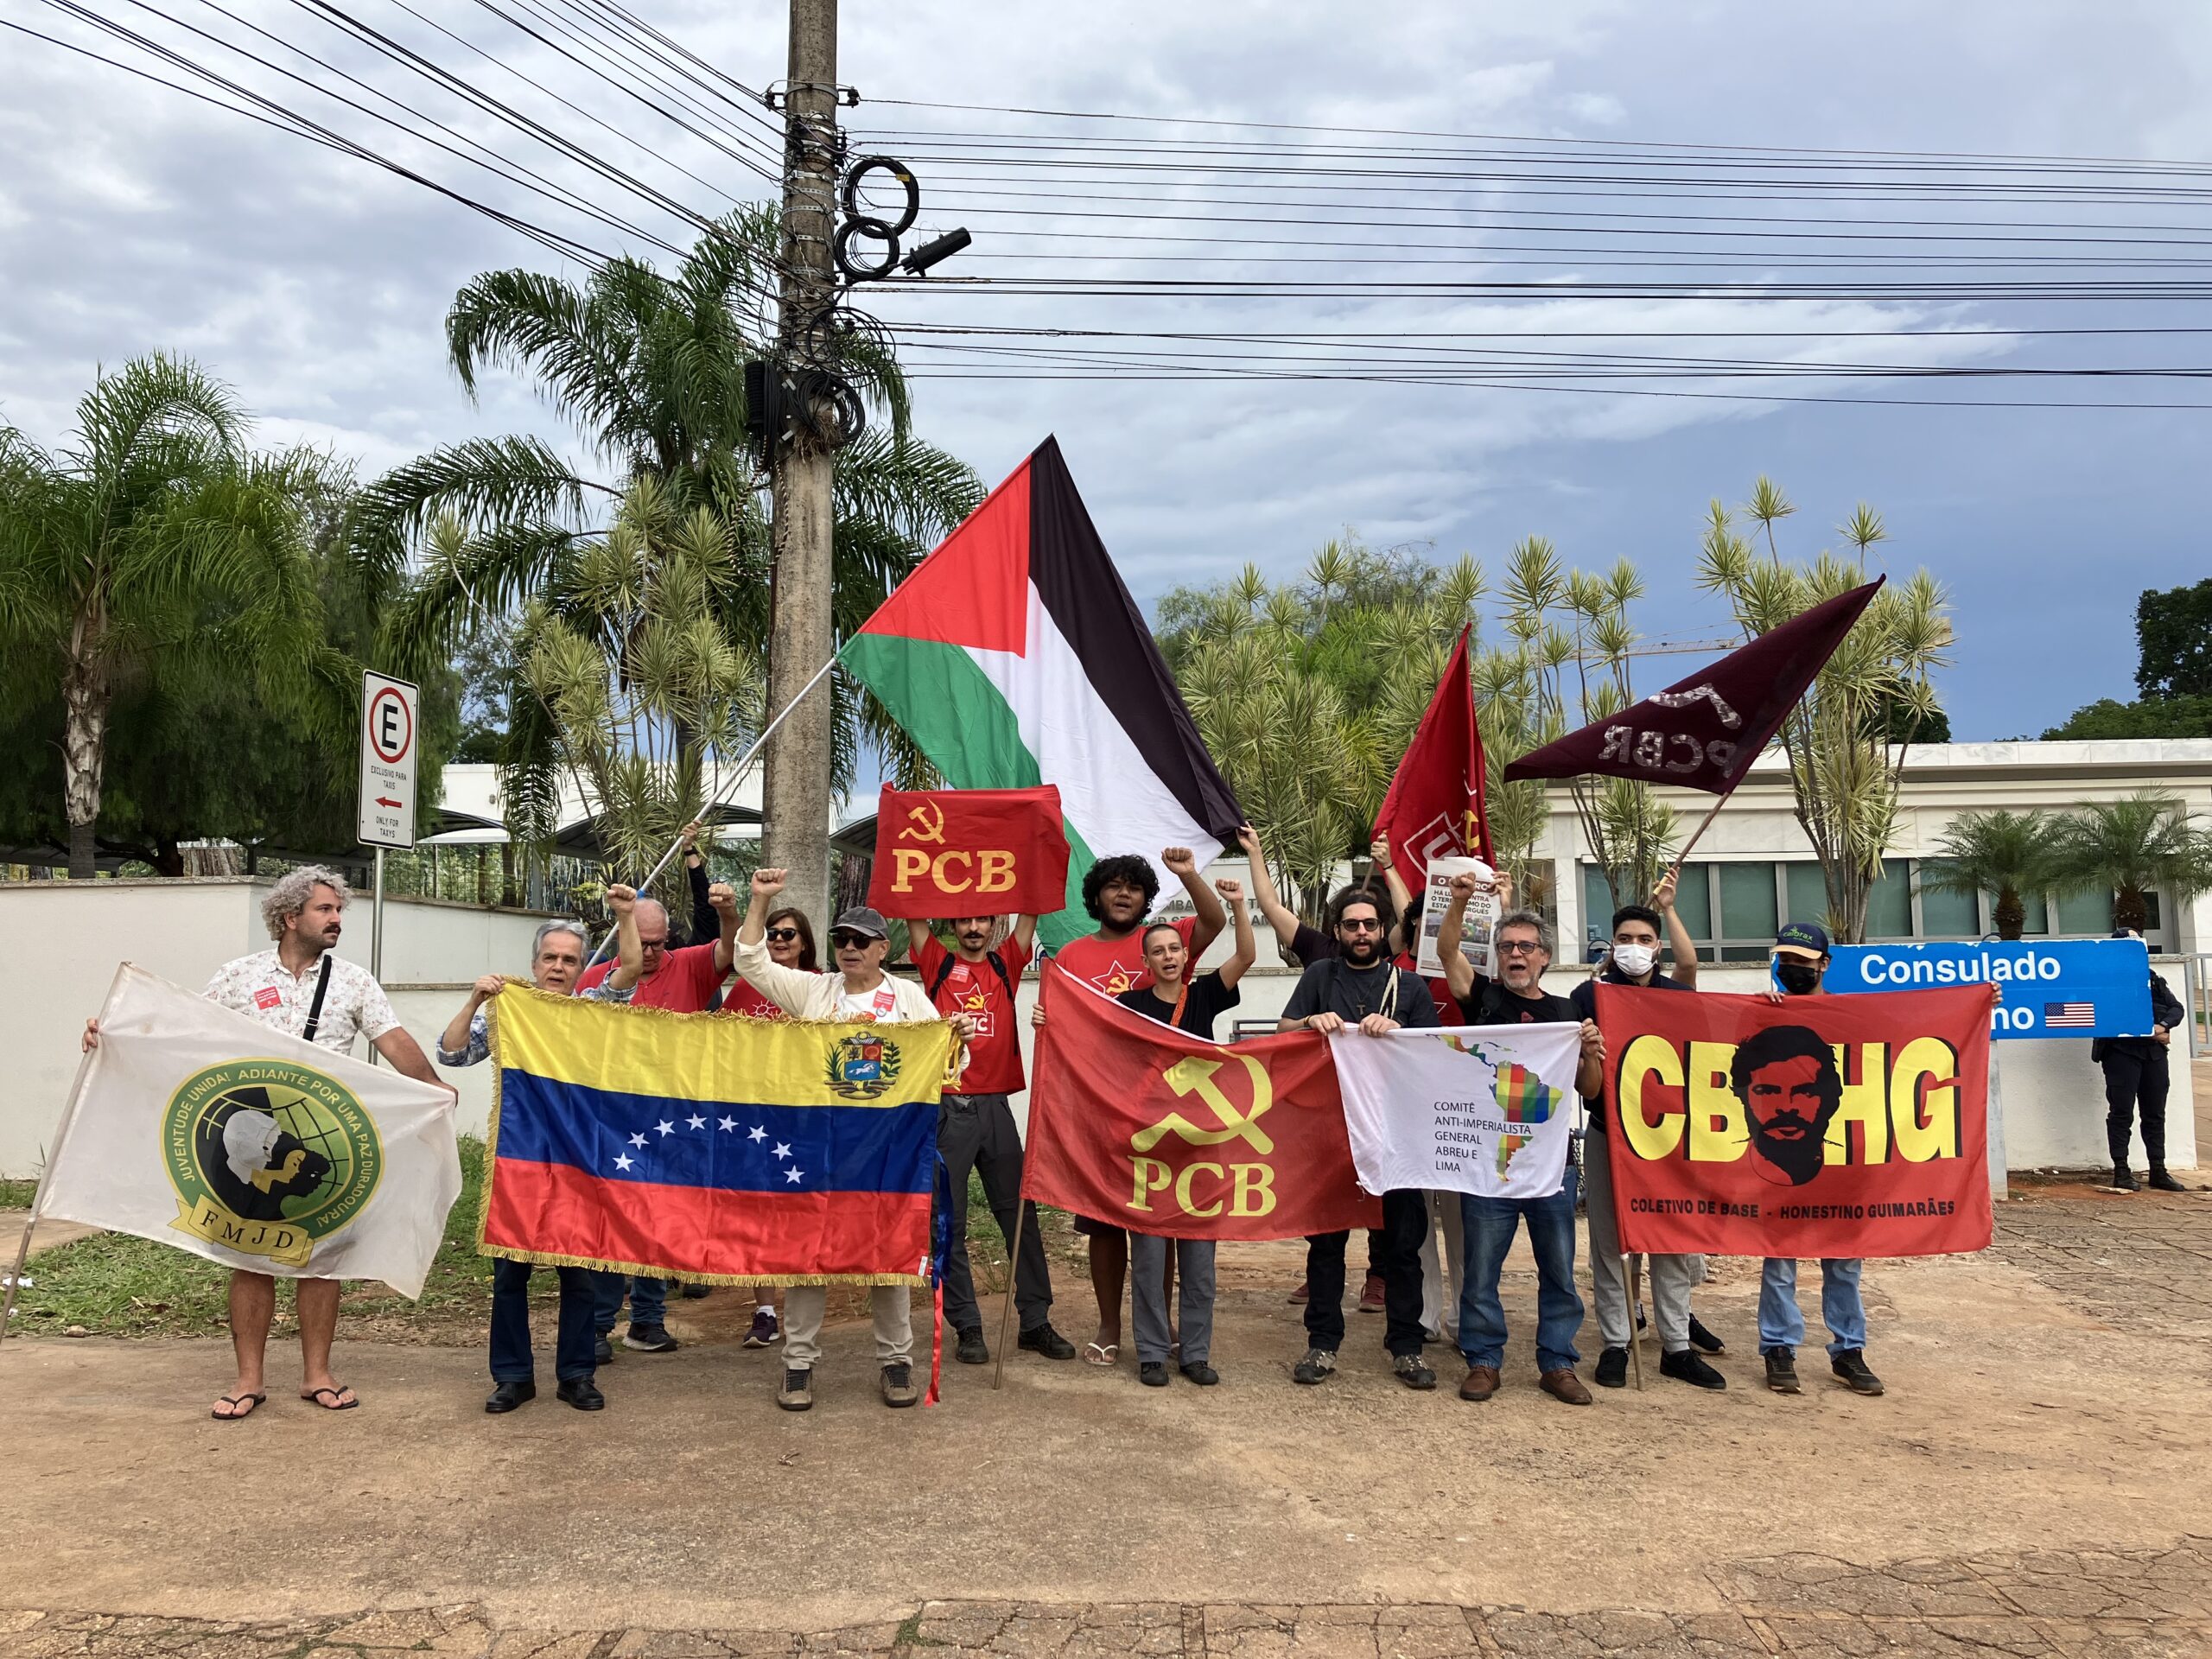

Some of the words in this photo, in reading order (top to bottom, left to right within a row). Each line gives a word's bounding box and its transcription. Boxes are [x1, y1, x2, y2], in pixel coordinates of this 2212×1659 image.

[381, 702, 398, 750] E
[370, 766, 395, 778] EXCLUSIVO
[395, 772, 407, 781] PARA
[383, 780, 396, 790] TAXIS
[375, 816, 389, 827] ONLY
[389, 818, 399, 828] FOR
[379, 828, 396, 838] TAXYS
[891, 849, 1017, 894] PCB
[1438, 877, 1446, 886] O
[1860, 950, 2061, 984] Consulado
[188, 1071, 232, 1101] UNIDA!
[238, 1068, 310, 1086] ADIANTE
[310, 1080, 340, 1105] POR
[1433, 1101, 1476, 1114] COMITÊ
[338, 1102, 362, 1134] UMA
[1434, 1116, 1532, 1135] ANTI-IMPERIALISTA
[173, 1101, 195, 1181] JUVENTUDE
[356, 1133, 372, 1159] PAZ
[1434, 1130, 1483, 1145] GENERAL
[1435, 1146, 1469, 1159] ABREU
[1471, 1149, 1478, 1160] E
[1435, 1160, 1461, 1173] LIMA
[316, 1160, 373, 1228] DURADOURA!
[1126, 1154, 1277, 1217] PCB
[1630, 1198, 1693, 1215] COLETIVO
[1697, 1200, 1715, 1215] DE
[1719, 1203, 1759, 1218] BASE
[1780, 1205, 1864, 1220] HONESTINO
[1867, 1198, 1955, 1218] GUIMARÃES
